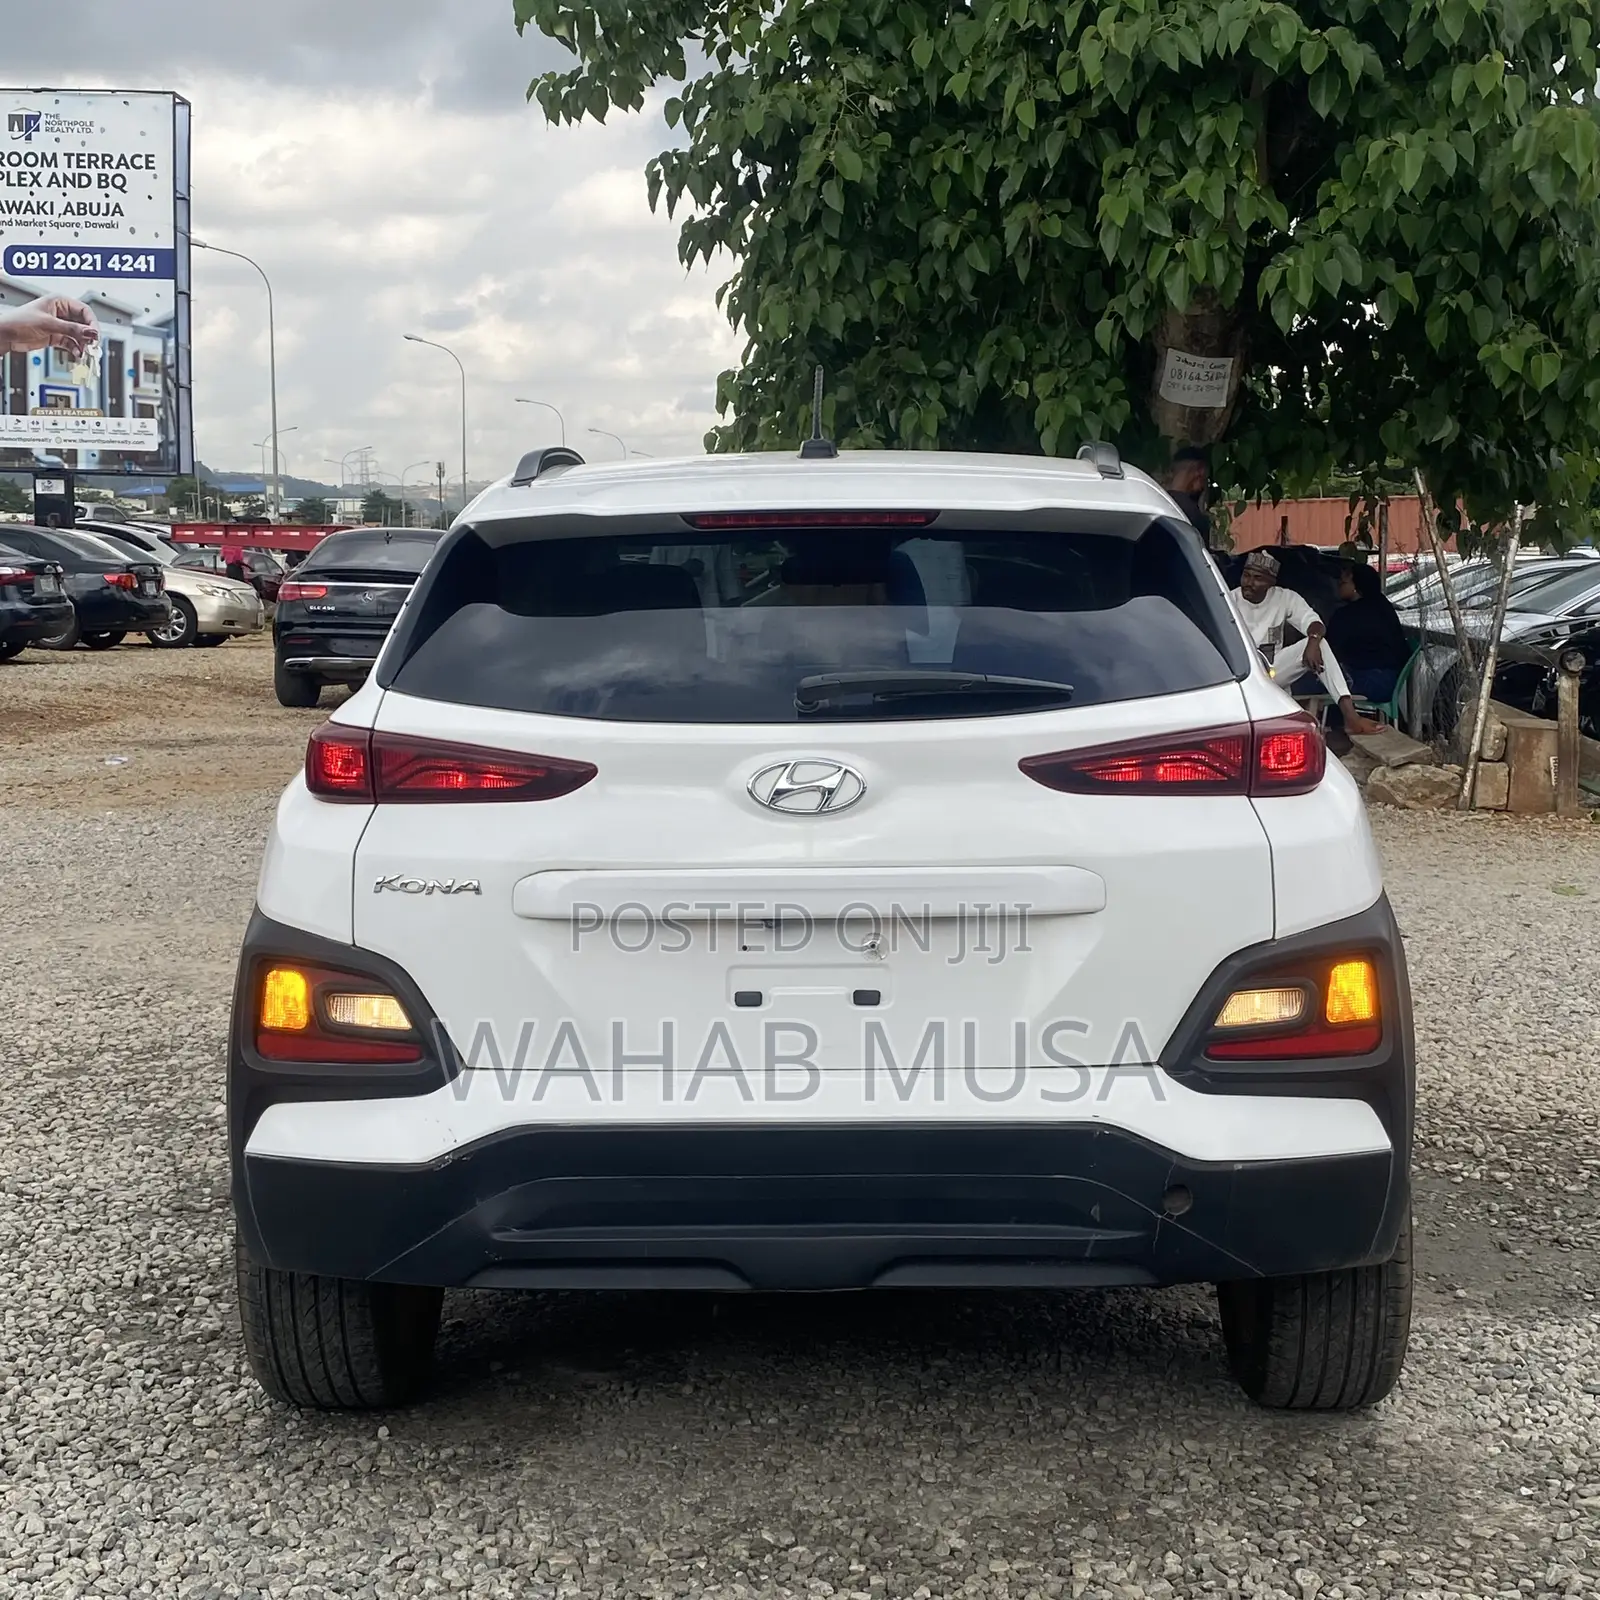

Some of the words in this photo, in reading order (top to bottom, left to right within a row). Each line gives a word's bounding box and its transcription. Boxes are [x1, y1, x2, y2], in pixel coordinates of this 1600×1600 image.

[45, 126, 75, 134] REALTY
[63, 152, 156, 170] TERRACE
[46, 172, 92, 188] AND
[97, 173, 128, 194] BQ
[0, 218, 13, 227] nd
[15, 218, 47, 228] Market
[84, 220, 119, 230] Dawaki
[12, 251, 48, 269] 091
[53, 252, 101, 271] 2021
[107, 254, 155, 272] 4241
[373, 873, 482, 895] KONA
